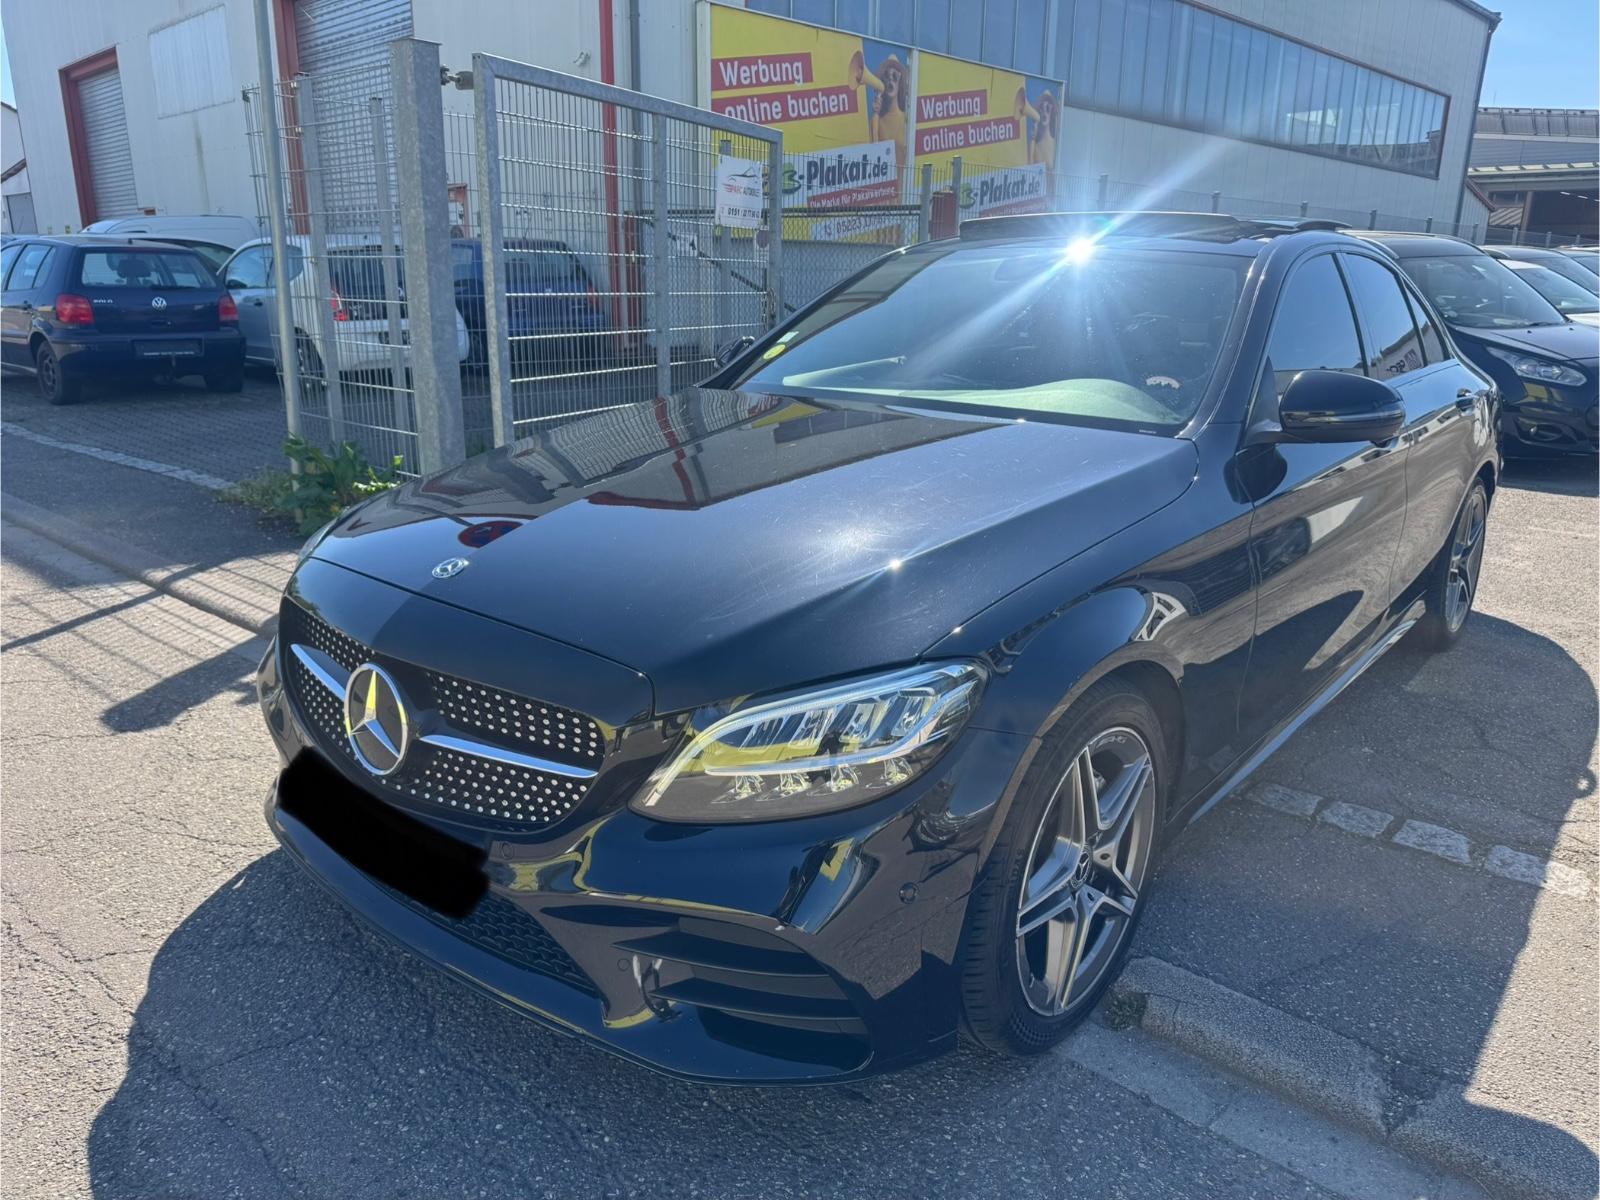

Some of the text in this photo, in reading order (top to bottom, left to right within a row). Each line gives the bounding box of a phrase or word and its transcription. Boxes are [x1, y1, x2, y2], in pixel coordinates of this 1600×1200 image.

[719, 59, 803, 87] Werbung
[787, 91, 849, 118] buchen
[921, 96, 980, 120] Werbung
[923, 121, 1013, 152] online buchen
